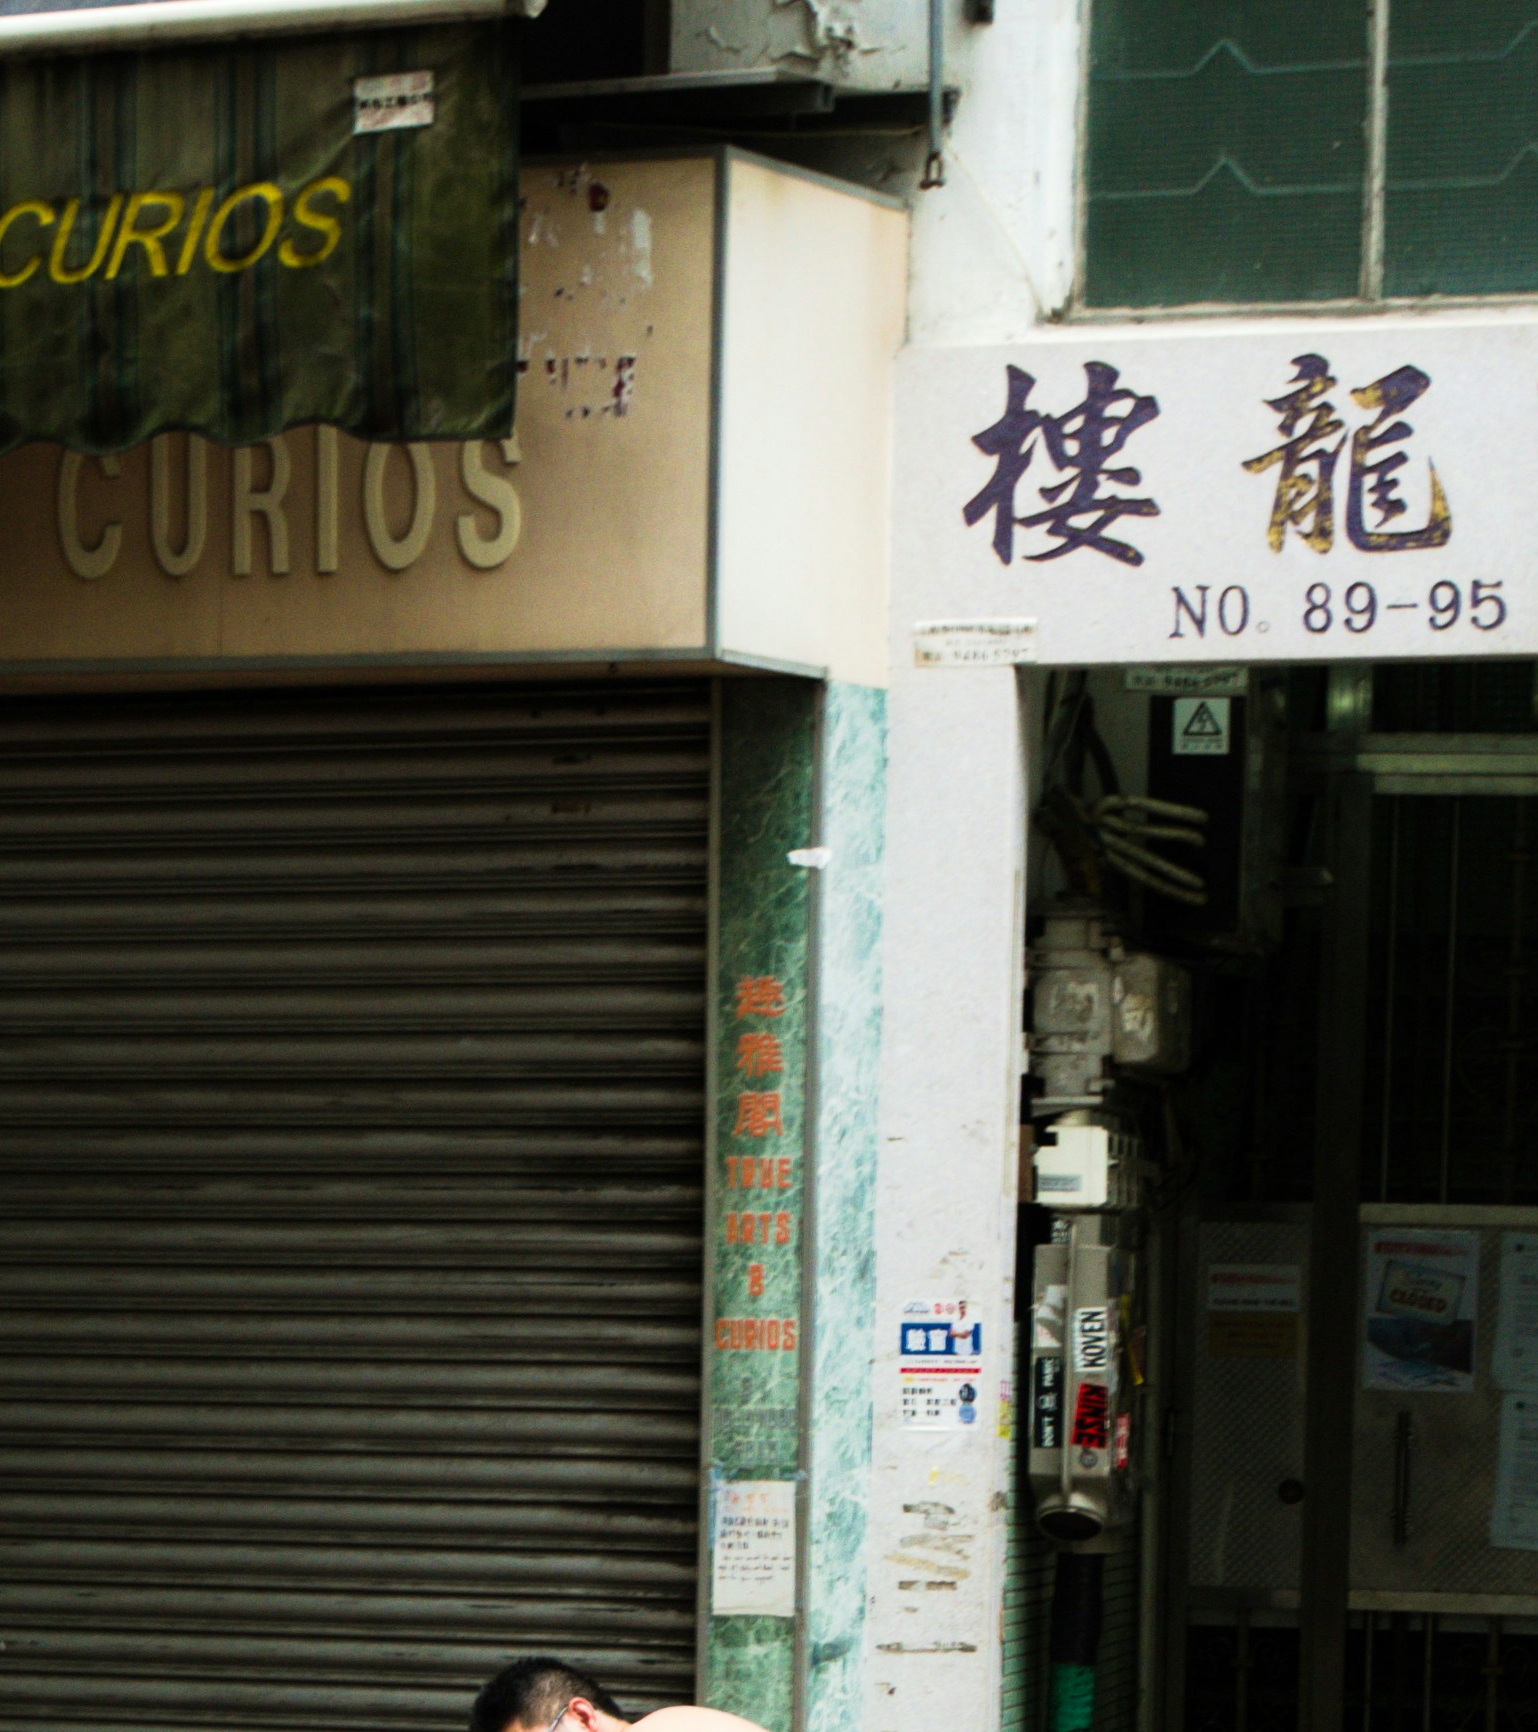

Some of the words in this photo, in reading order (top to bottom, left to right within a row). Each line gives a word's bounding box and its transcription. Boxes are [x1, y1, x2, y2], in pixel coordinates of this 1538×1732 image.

[58, 423, 521, 579] CURIOS
[1302, 579, 1509, 632] 89-95
[724, 1211, 792, 1246] ARTS
[715, 1317, 796, 1351] CURIOS
[1080, 1310, 1106, 1369] KOVEN
